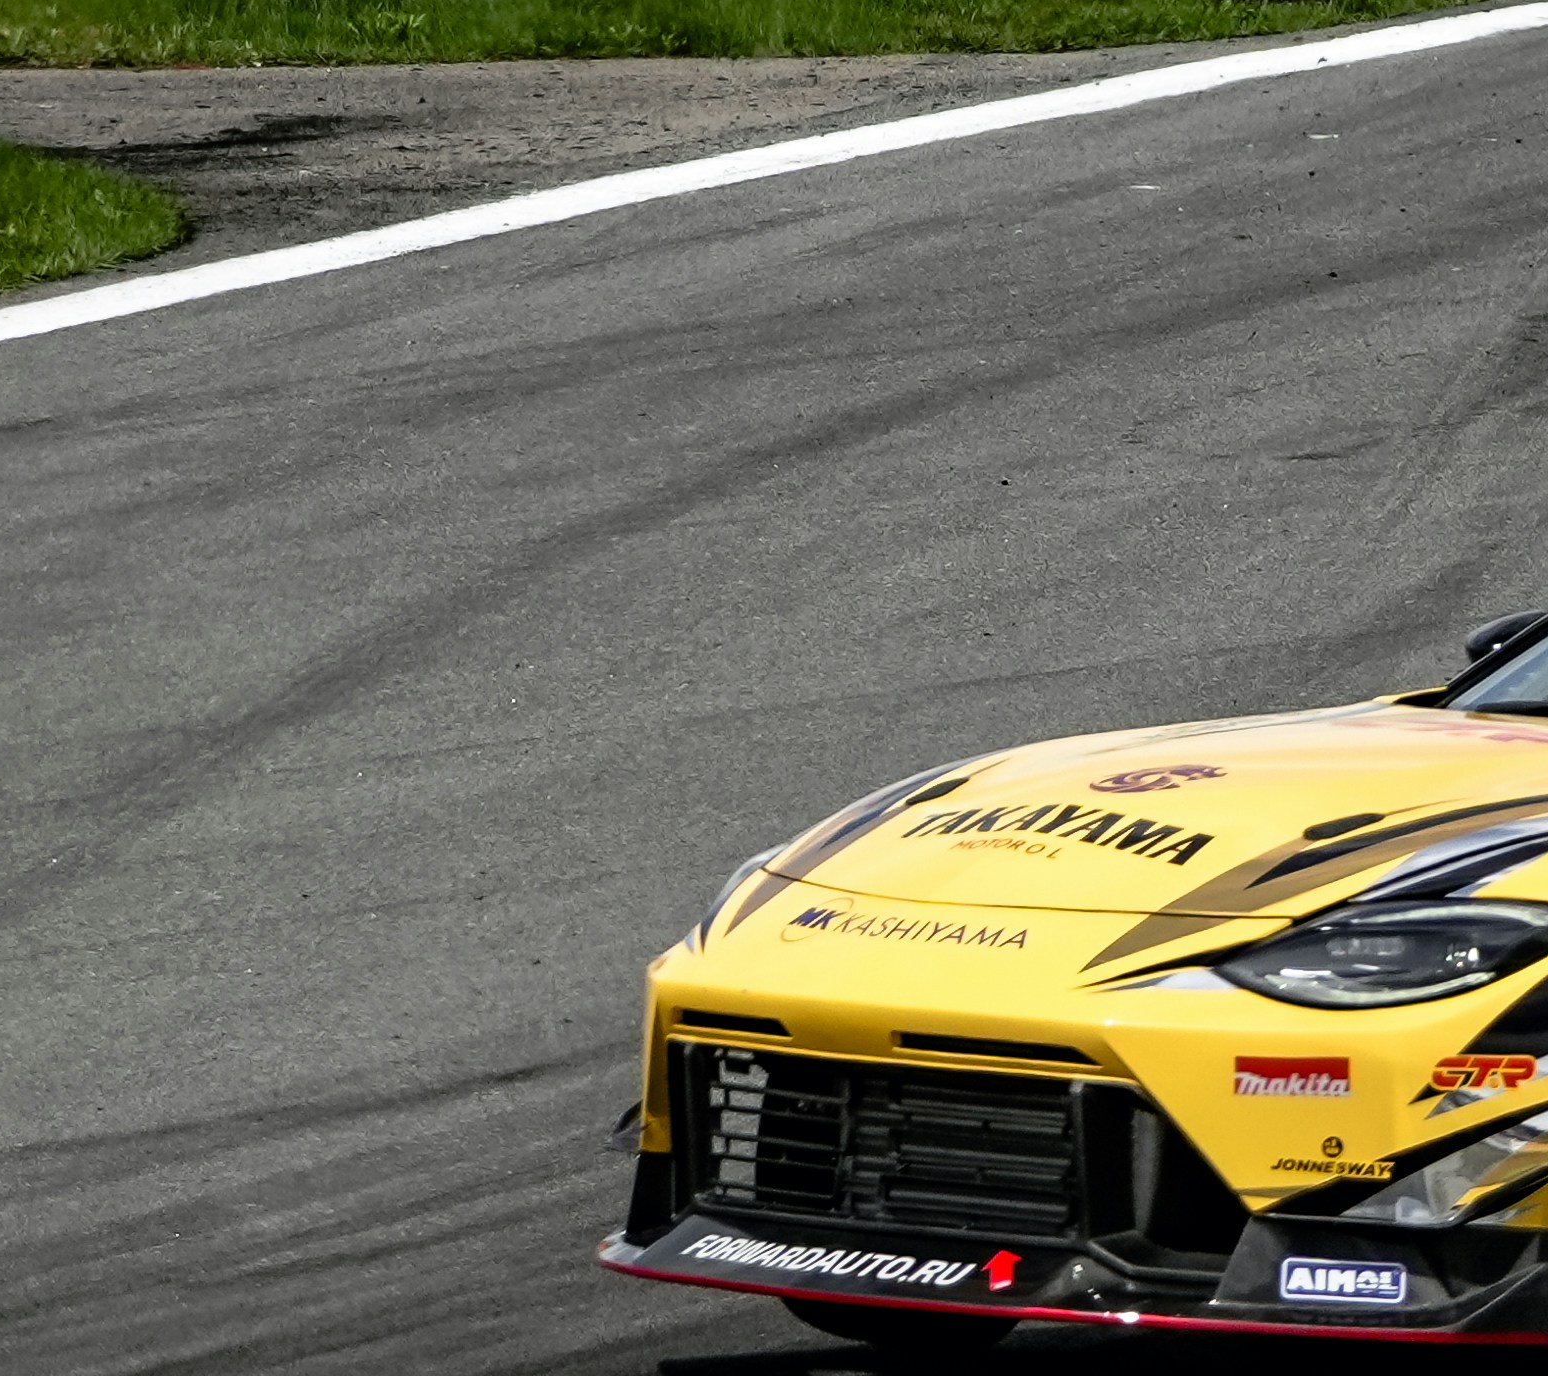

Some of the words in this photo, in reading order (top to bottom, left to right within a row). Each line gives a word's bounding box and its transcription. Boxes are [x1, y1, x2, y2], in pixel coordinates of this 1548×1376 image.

[901, 803, 1216, 866] TAKAYAMA
[950, 838, 1027, 852] MOTOR
[789, 907, 846, 931] MK
[833, 913, 1029, 949] KASHIYAMA
[1271, 1157, 1393, 1178] JONNESWAY
[680, 1234, 977, 1287] FORWARDAUTO.RU
[1286, 1267, 1399, 1295] AIMOL
